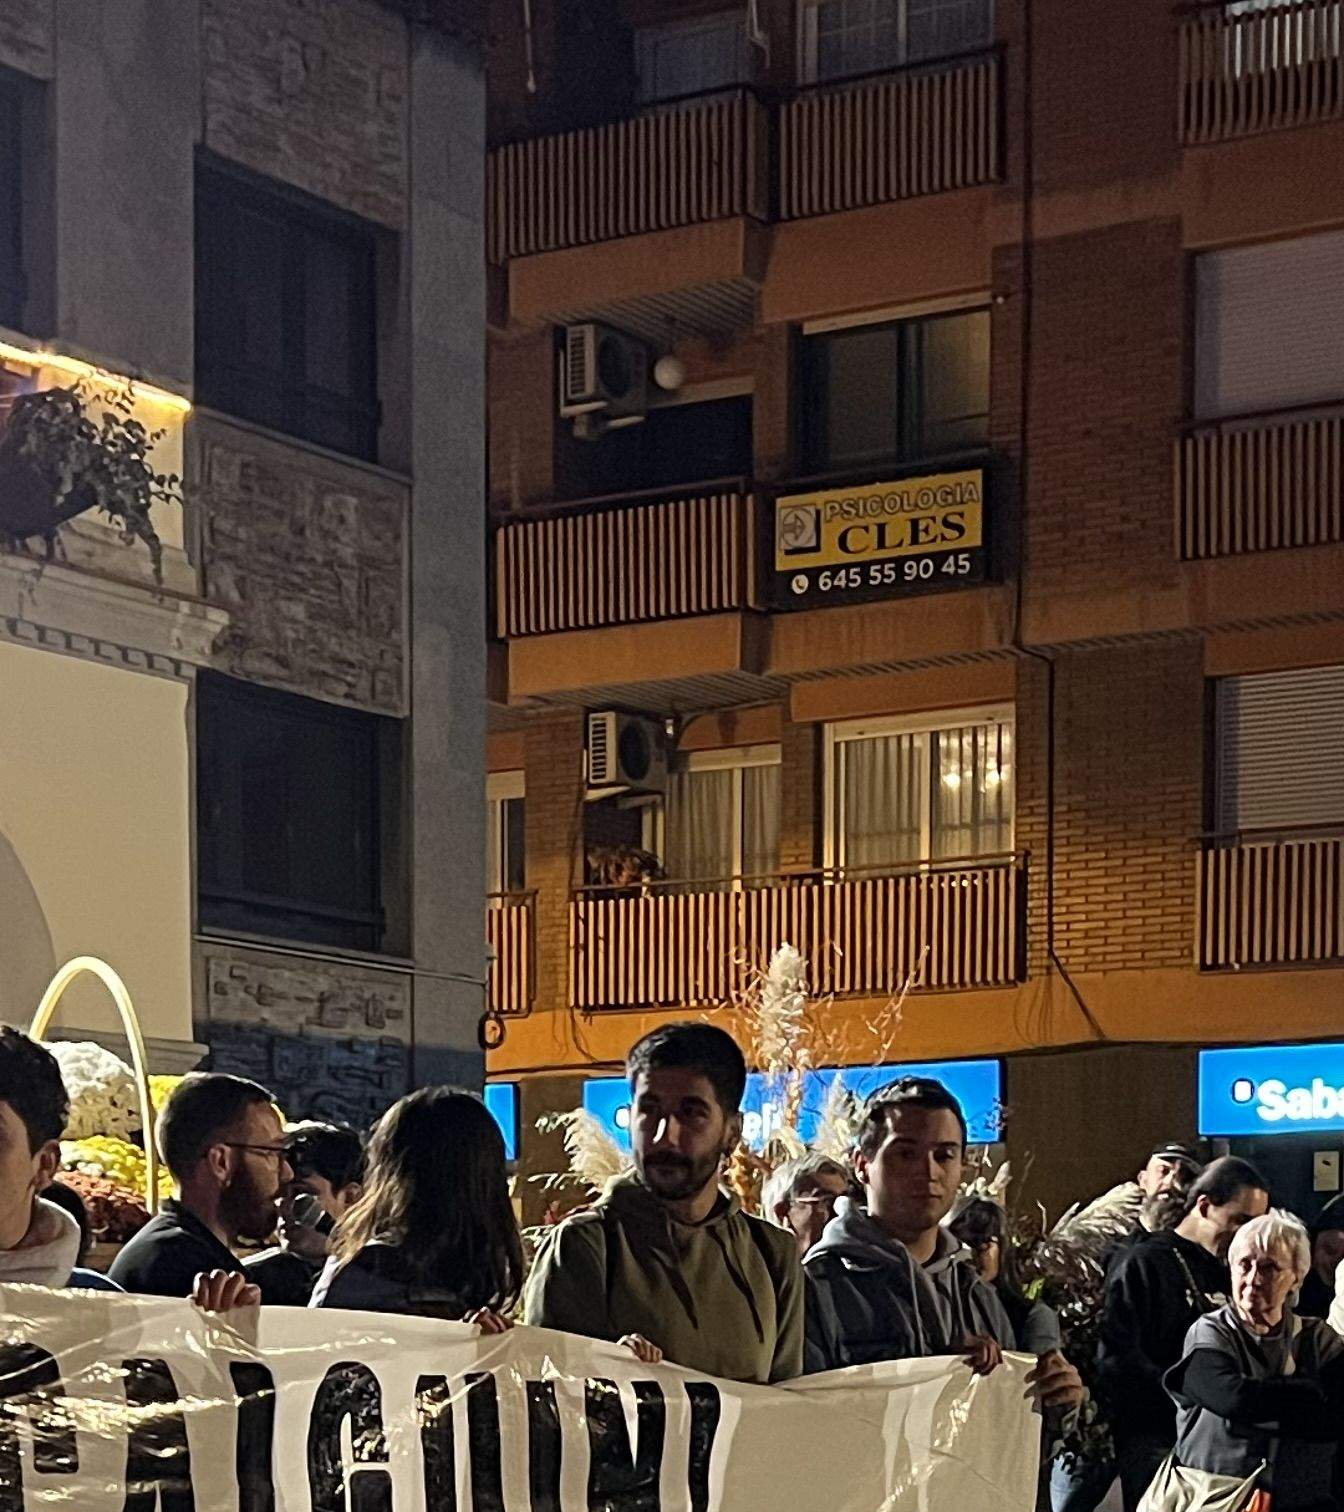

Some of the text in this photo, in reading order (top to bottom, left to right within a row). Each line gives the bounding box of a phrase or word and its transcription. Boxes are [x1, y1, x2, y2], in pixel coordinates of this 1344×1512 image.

[824, 482, 980, 522] PSICOLOGIA
[838, 512, 965, 555] CLES
[818, 553, 971, 591] 645 55 90 45
